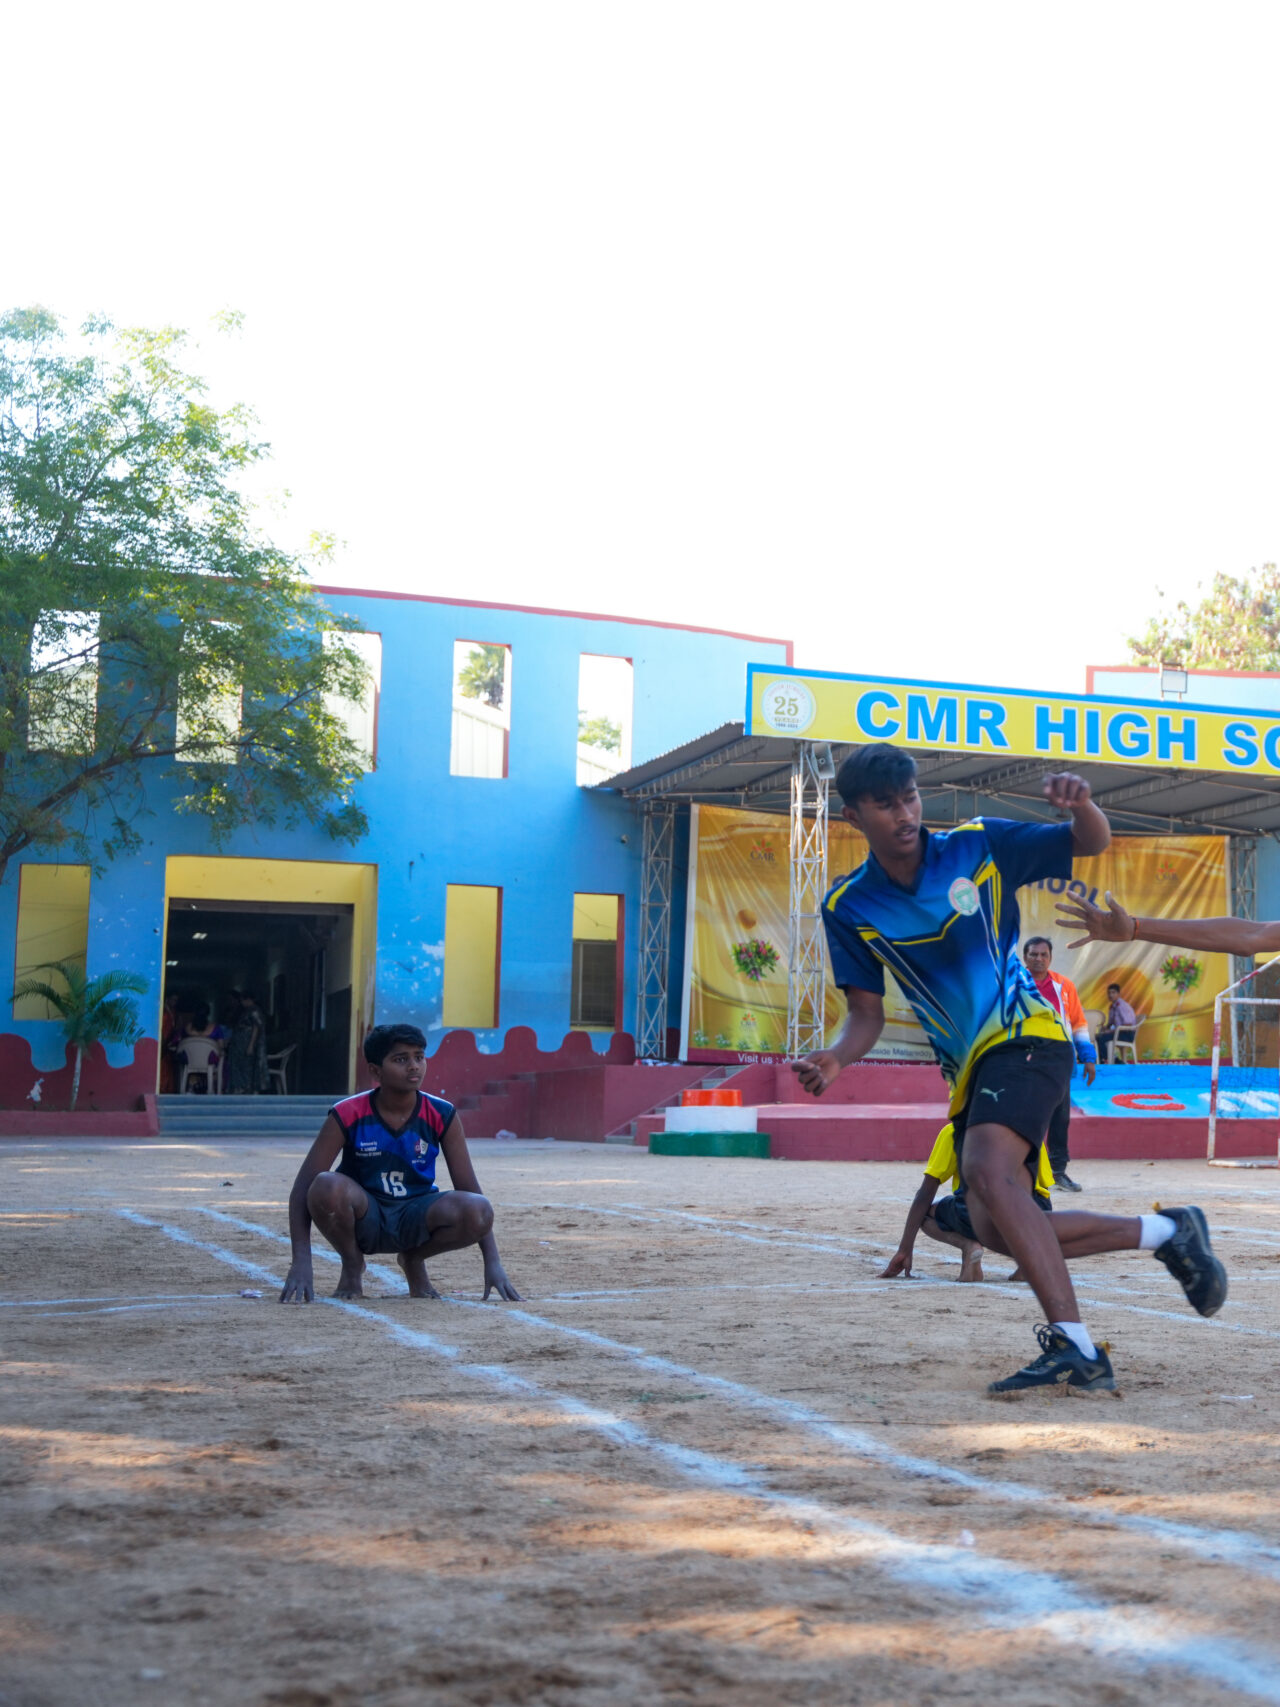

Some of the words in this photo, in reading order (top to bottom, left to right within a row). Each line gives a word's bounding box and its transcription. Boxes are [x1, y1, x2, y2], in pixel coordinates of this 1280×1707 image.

[774, 696, 799, 717] 25
[855, 690, 1010, 748] CMR
[1035, 706, 1197, 762] HIGH
[737, 1052, 758, 1064] Visit
[761, 1056, 773, 1064] us
